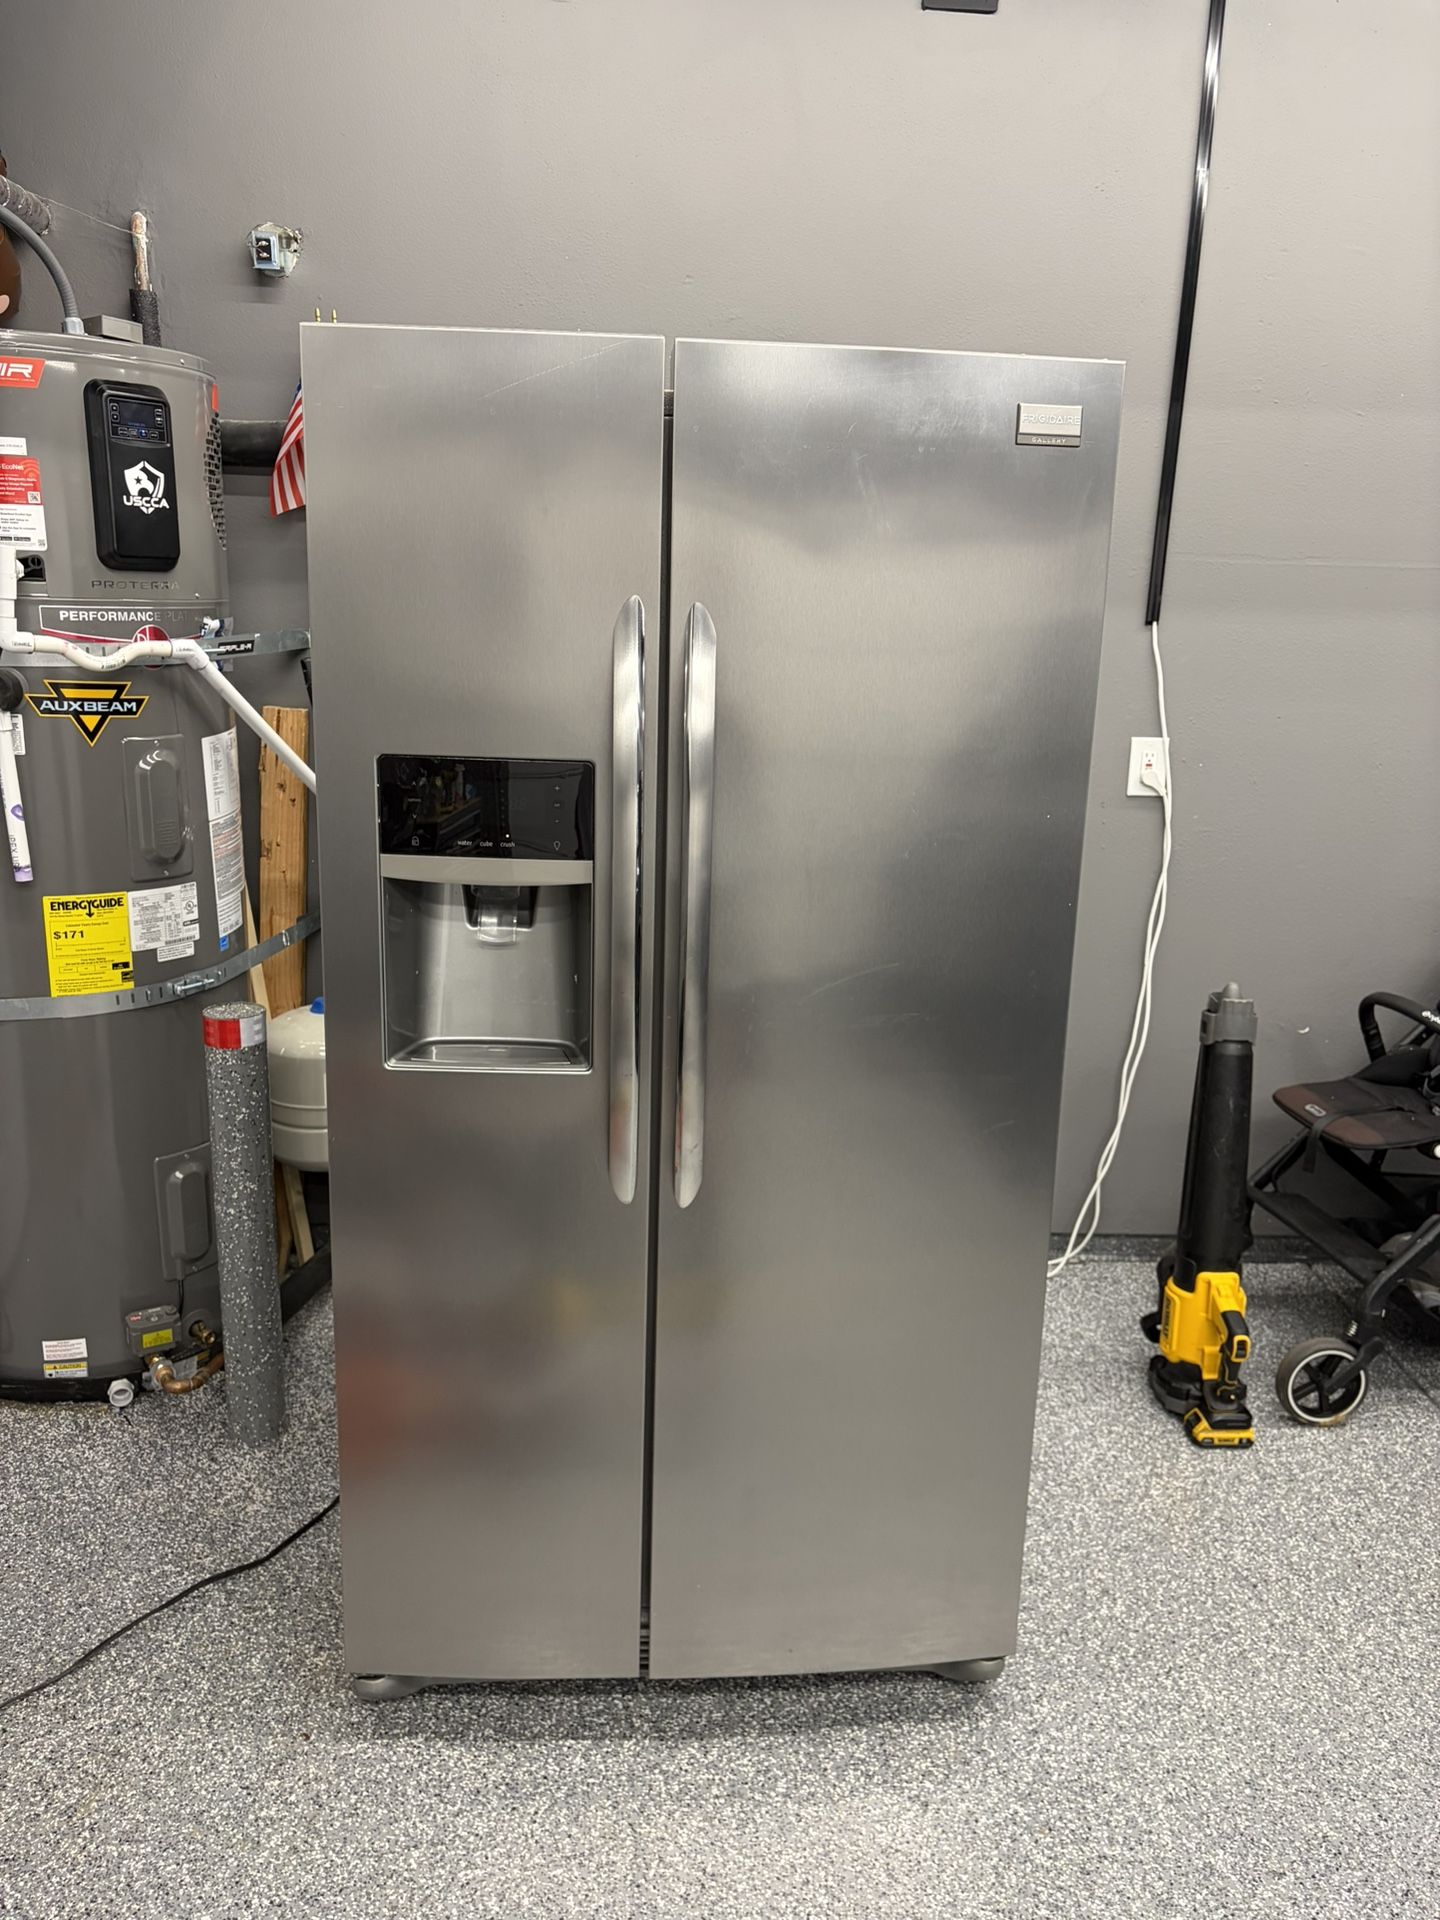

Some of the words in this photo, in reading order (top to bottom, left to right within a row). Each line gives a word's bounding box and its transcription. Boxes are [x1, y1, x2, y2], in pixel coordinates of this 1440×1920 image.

[0, 363, 32, 378] IR
[1023, 413, 1081, 425] FRIGIDAIRE
[1031, 436, 1066, 444] GALLERY
[123, 495, 170, 509] USCCA
[91, 580, 180, 590] PROTERRA
[59, 610, 160, 621] PERFORMANCE
[40, 700, 137, 712] AUXBEAM
[457, 839, 473, 847] water
[479, 840, 494, 848] cube
[50, 896, 125, 912] ENERGYGUIDE
[53, 930, 84, 940] $171
